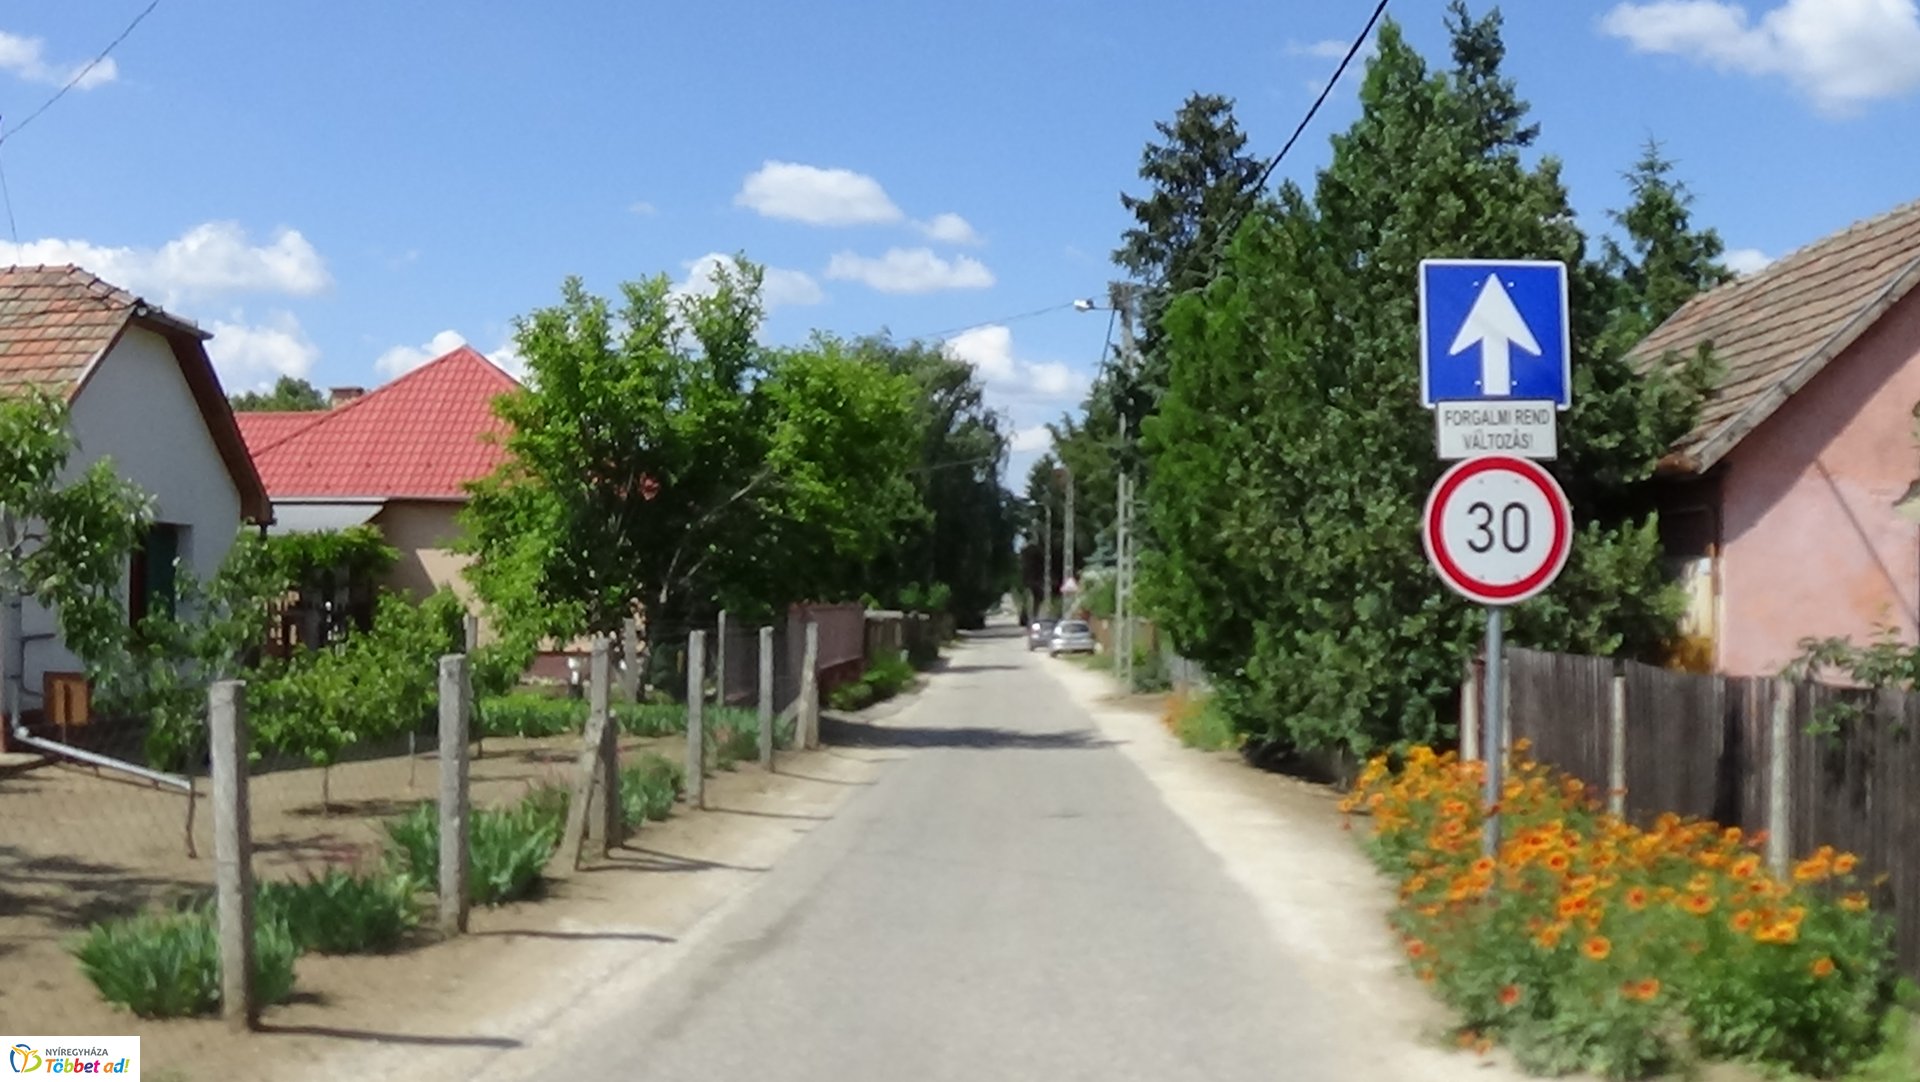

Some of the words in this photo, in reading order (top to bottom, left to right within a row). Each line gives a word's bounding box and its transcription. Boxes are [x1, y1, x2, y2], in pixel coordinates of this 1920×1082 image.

[1445, 410, 1512, 426] FORGALMI
[1515, 409, 1550, 425] REND
[1463, 429, 1533, 449] VÁLTOZÁS!
[1467, 502, 1530, 553] 30
